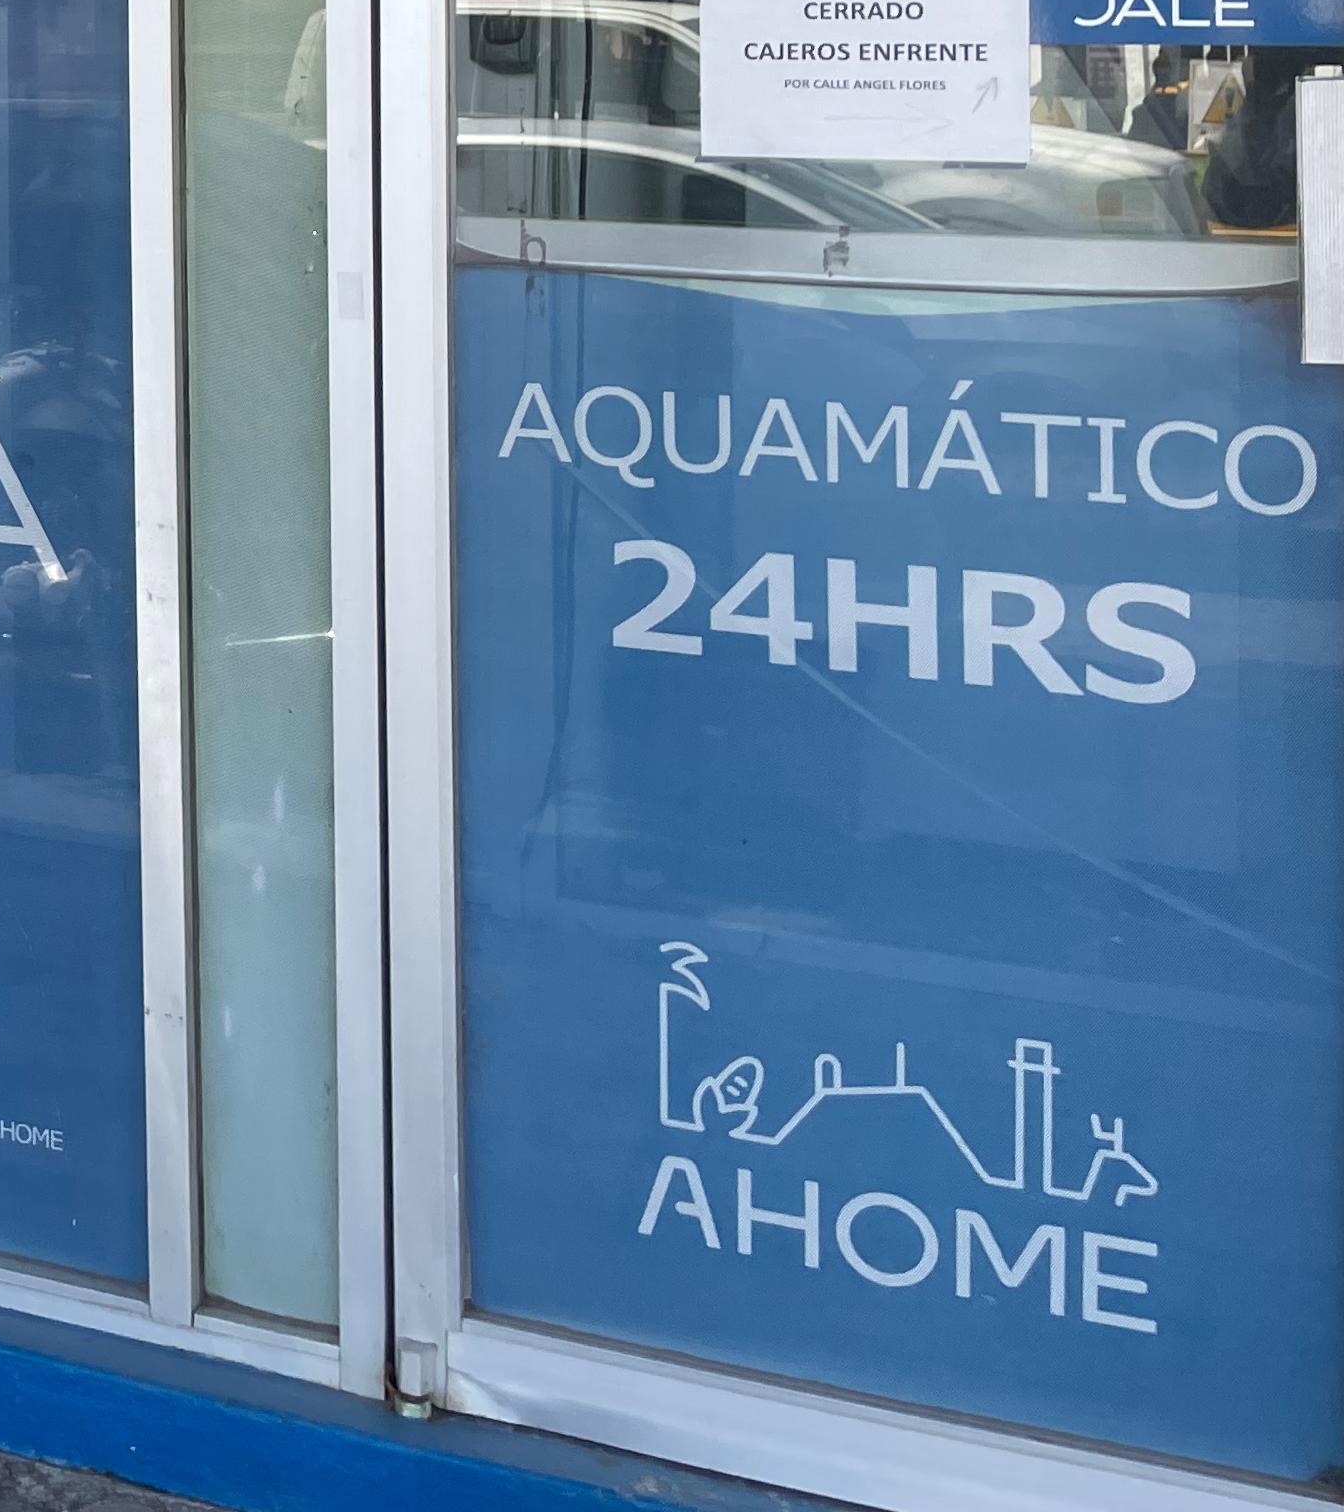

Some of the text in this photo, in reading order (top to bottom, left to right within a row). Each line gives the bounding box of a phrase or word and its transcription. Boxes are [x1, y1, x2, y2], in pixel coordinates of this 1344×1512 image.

[803, 0, 925, 22] CERRADO
[743, 40, 989, 64] CAJEROS ENFRENTE
[784, 79, 947, 92] POR CALLE ANGEL FLORES
[498, 378, 1317, 516] AQUAMÁTICO
[611, 539, 1198, 705] 24HRS
[637, 1153, 1159, 1335] AHOME
